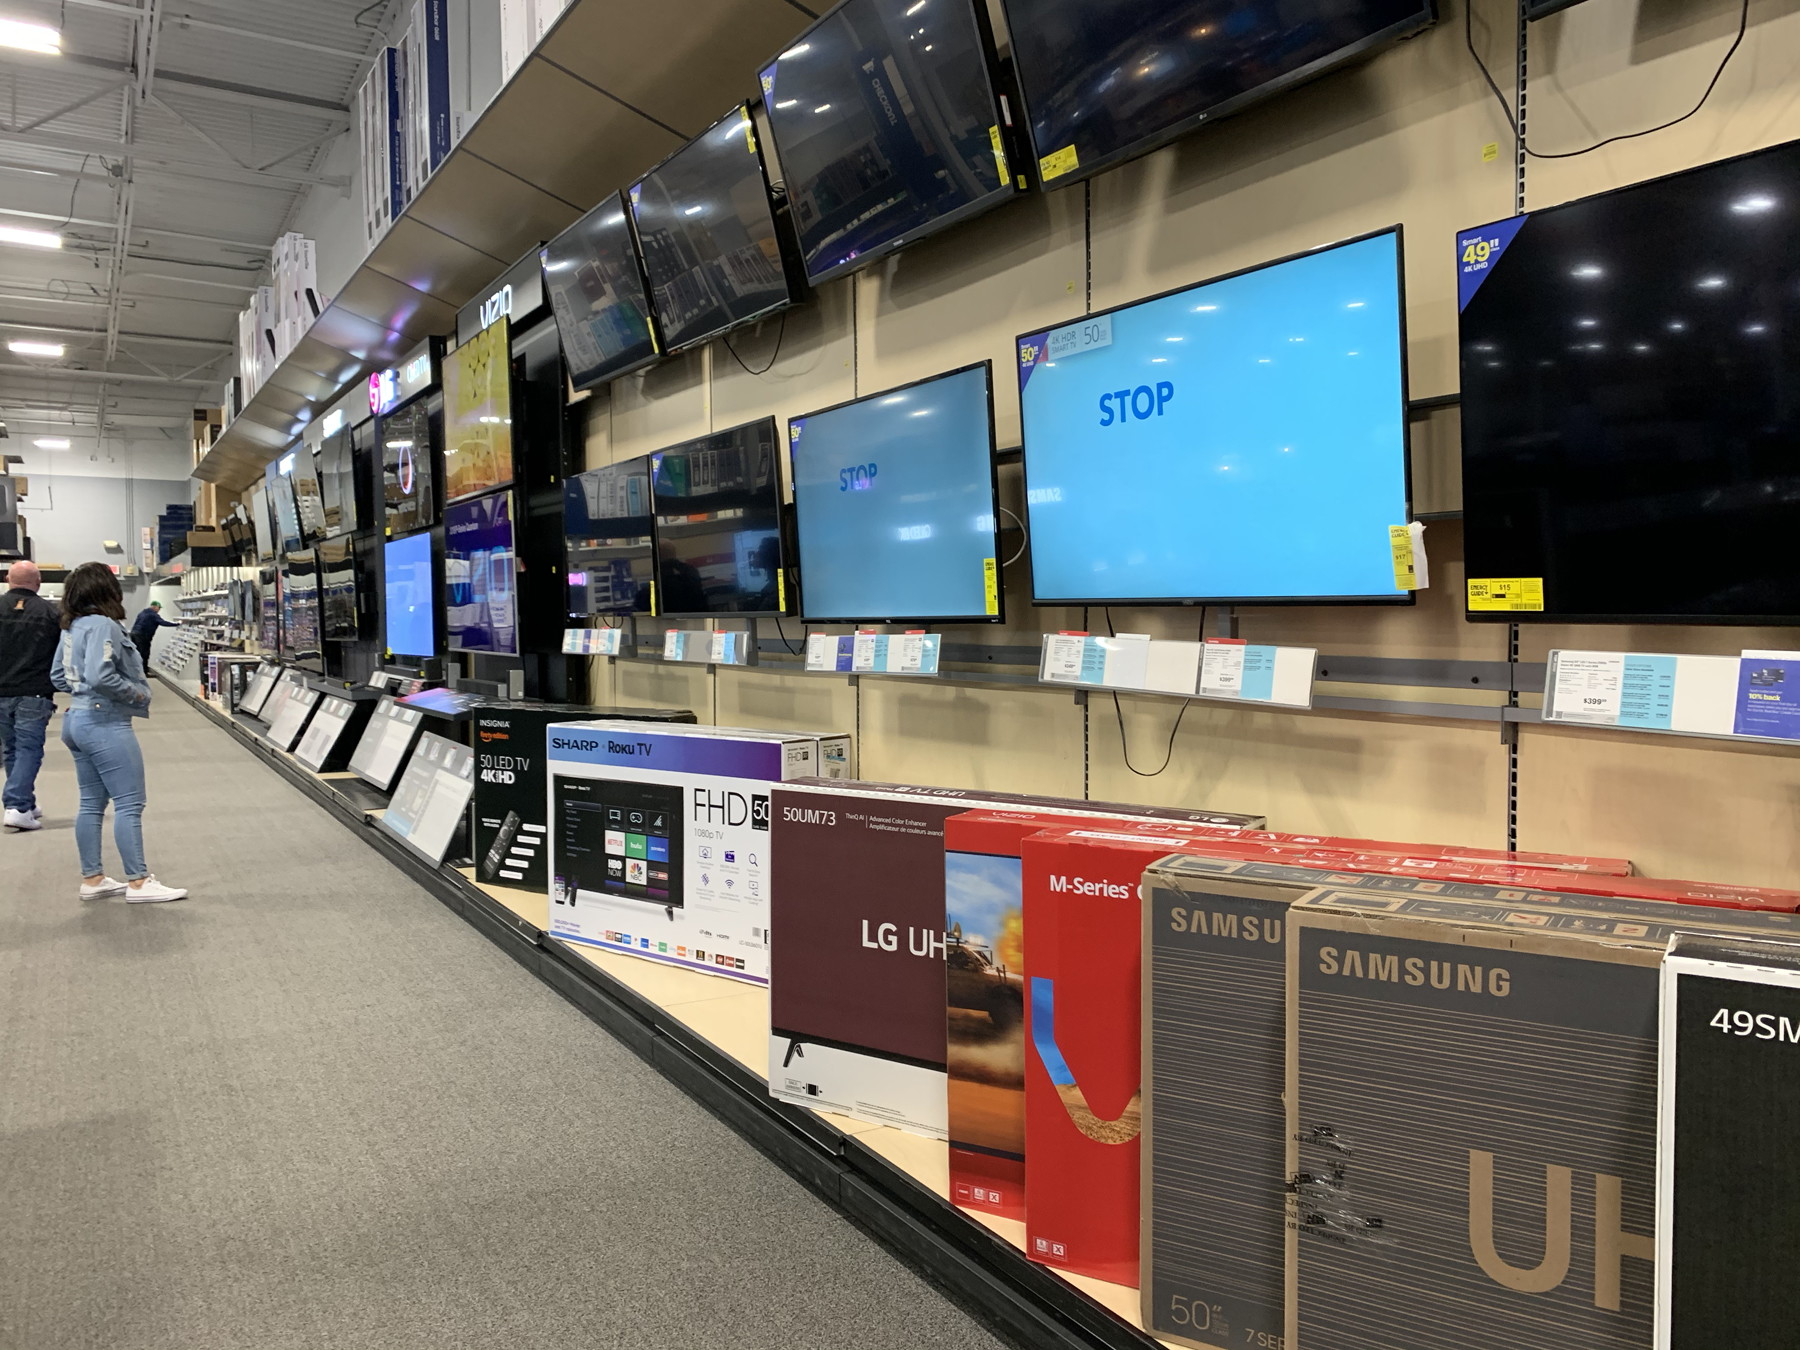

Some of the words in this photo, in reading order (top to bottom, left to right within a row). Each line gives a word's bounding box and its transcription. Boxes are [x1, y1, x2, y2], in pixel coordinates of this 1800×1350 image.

[480, 284, 512, 330] VIZIO
[1062, 331, 1077, 342] HDR
[1099, 381, 1174, 427] STOP
[840, 463, 877, 492] STOP
[480, 720, 510, 728] INSIGNIA
[552, 738, 599, 752] SHARP
[636, 743, 652, 757] TV
[480, 755, 492, 768] 50
[494, 756, 514, 770] LED
[515, 757, 530, 771] TV
[694, 788, 748, 826] FHD
[783, 806, 836, 826] 50UM73
[992, 811, 1036, 819] VIZIO
[869, 823, 900, 832] Amplificateur
[907, 827, 927, 835] couleurs
[905, 819, 927, 827] Enhancer
[695, 828, 714, 839] 1080p
[715, 831, 724, 839] TV
[1170, 907, 1282, 944] SAMSU
[862, 919, 897, 951] LG
[909, 926, 946, 960] UH
[1319, 946, 1512, 998] SAMSUNG
[1709, 1008, 1800, 1044] 49SM
[1245, 1328, 1255, 1343] 7
